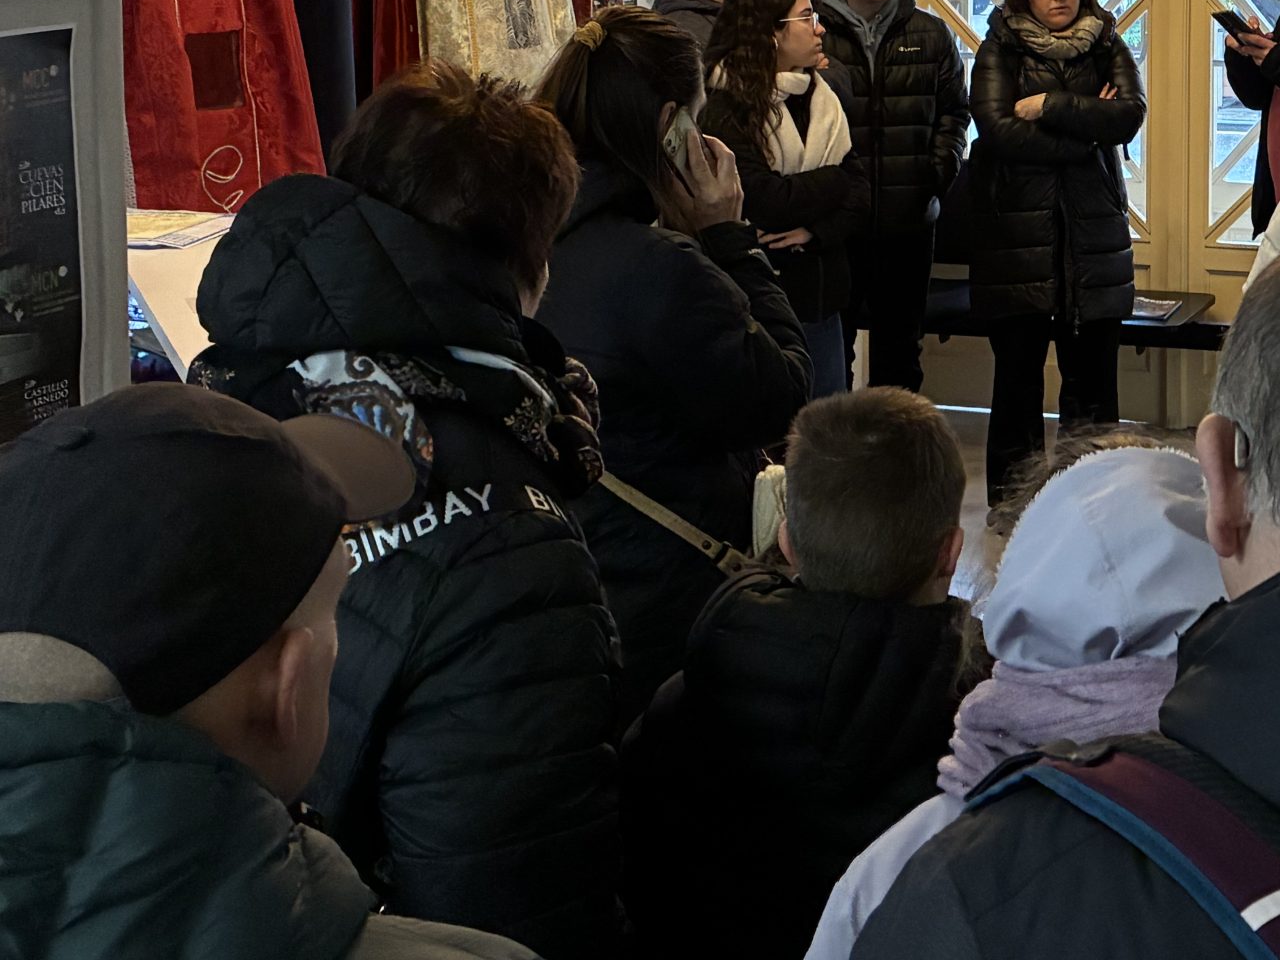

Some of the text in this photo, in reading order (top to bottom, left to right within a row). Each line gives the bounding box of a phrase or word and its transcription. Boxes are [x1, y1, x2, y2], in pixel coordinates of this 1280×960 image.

[19, 163, 64, 186] CUEVAS
[30, 178, 64, 198] CIEN
[20, 193, 66, 215] PILARES
[24, 379, 69, 400] CASTILLO
[32, 389, 69, 407] ARNEDO
